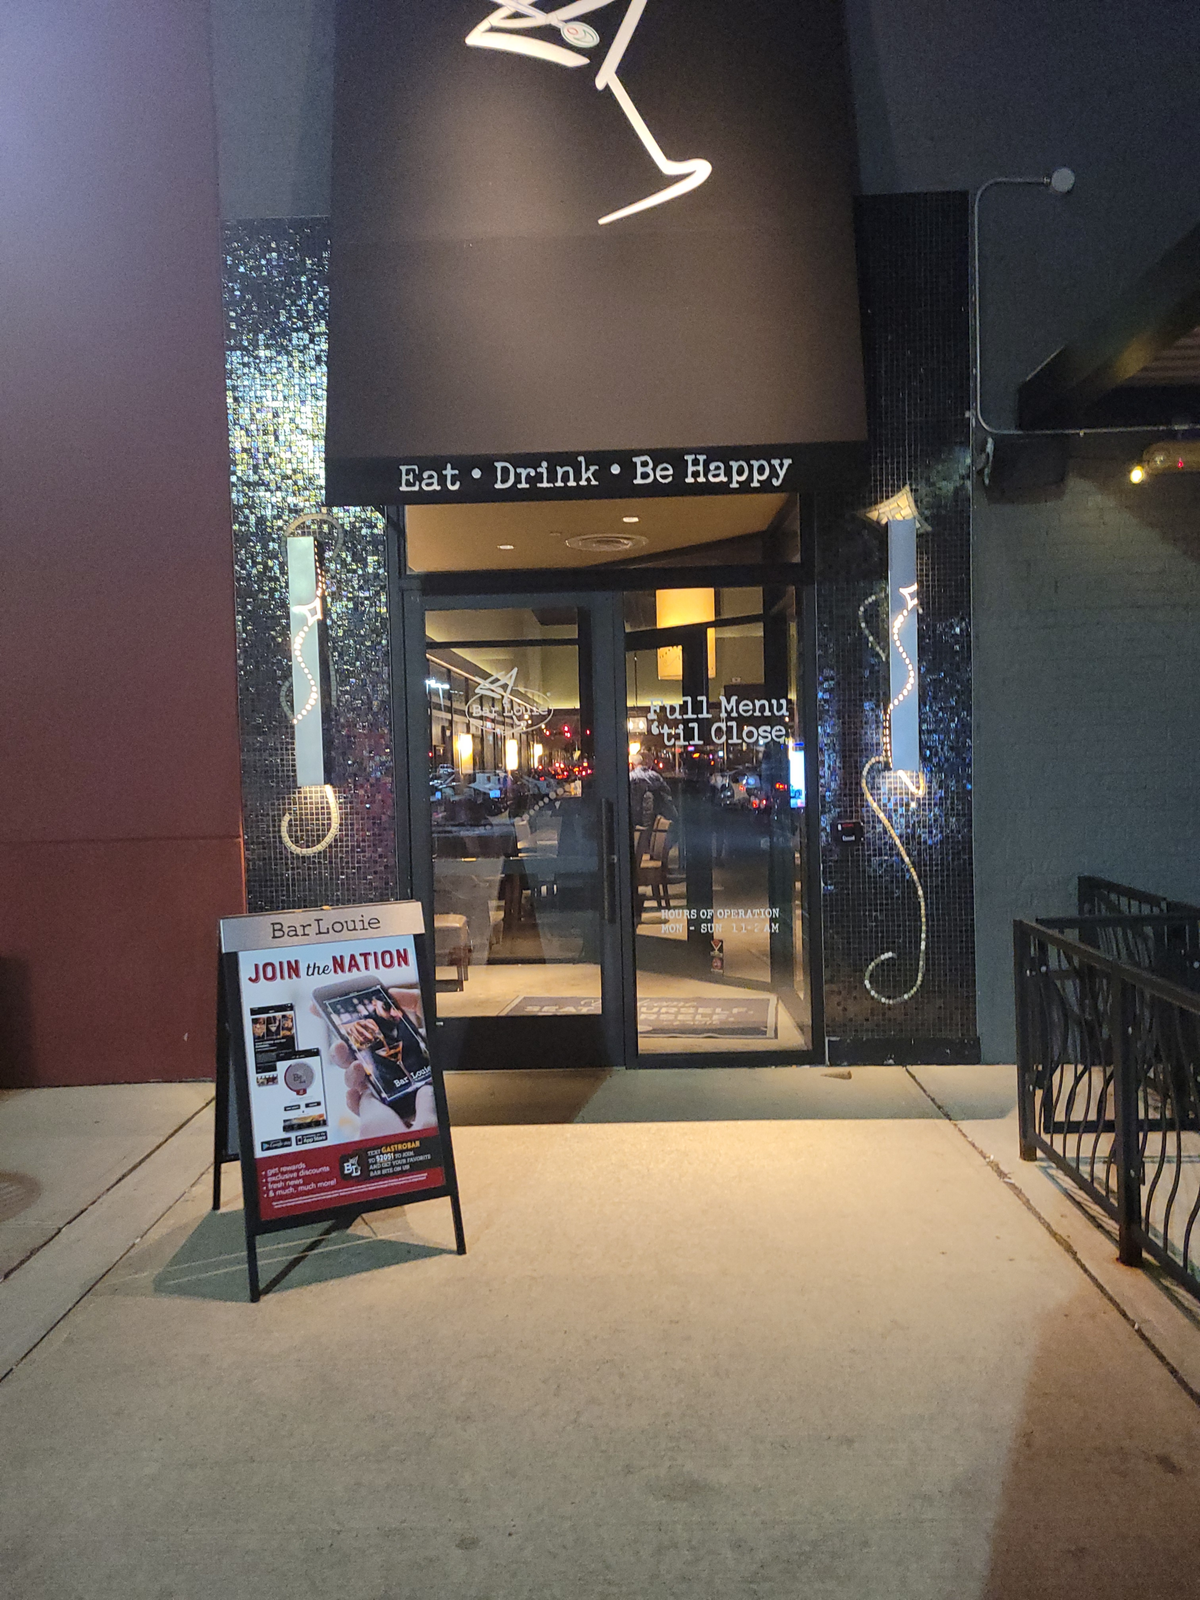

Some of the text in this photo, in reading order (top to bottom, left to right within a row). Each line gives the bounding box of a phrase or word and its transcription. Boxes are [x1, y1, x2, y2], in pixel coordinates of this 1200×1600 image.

[399, 454, 792, 492] Eat Drink Be Happy
[472, 704, 499, 719] Bar
[647, 695, 789, 720] Full Menu
[711, 721, 787, 744] Close
[661, 908, 780, 919] HOURS OF OPERATION
[270, 914, 381, 940] Bar Louie
[661, 923, 683, 934] MON
[700, 923, 722, 934] SUN
[248, 948, 411, 984] JOIN the NATION
[393, 1076, 410, 1088] Bar
[381, 1140, 421, 1153] GASTROBAR
[267, 1162, 306, 1176] get rewards
[267, 1166, 330, 1181] exclusive discounts
[268, 1178, 304, 1189] fresh news
[298, 1182, 317, 1191] much
